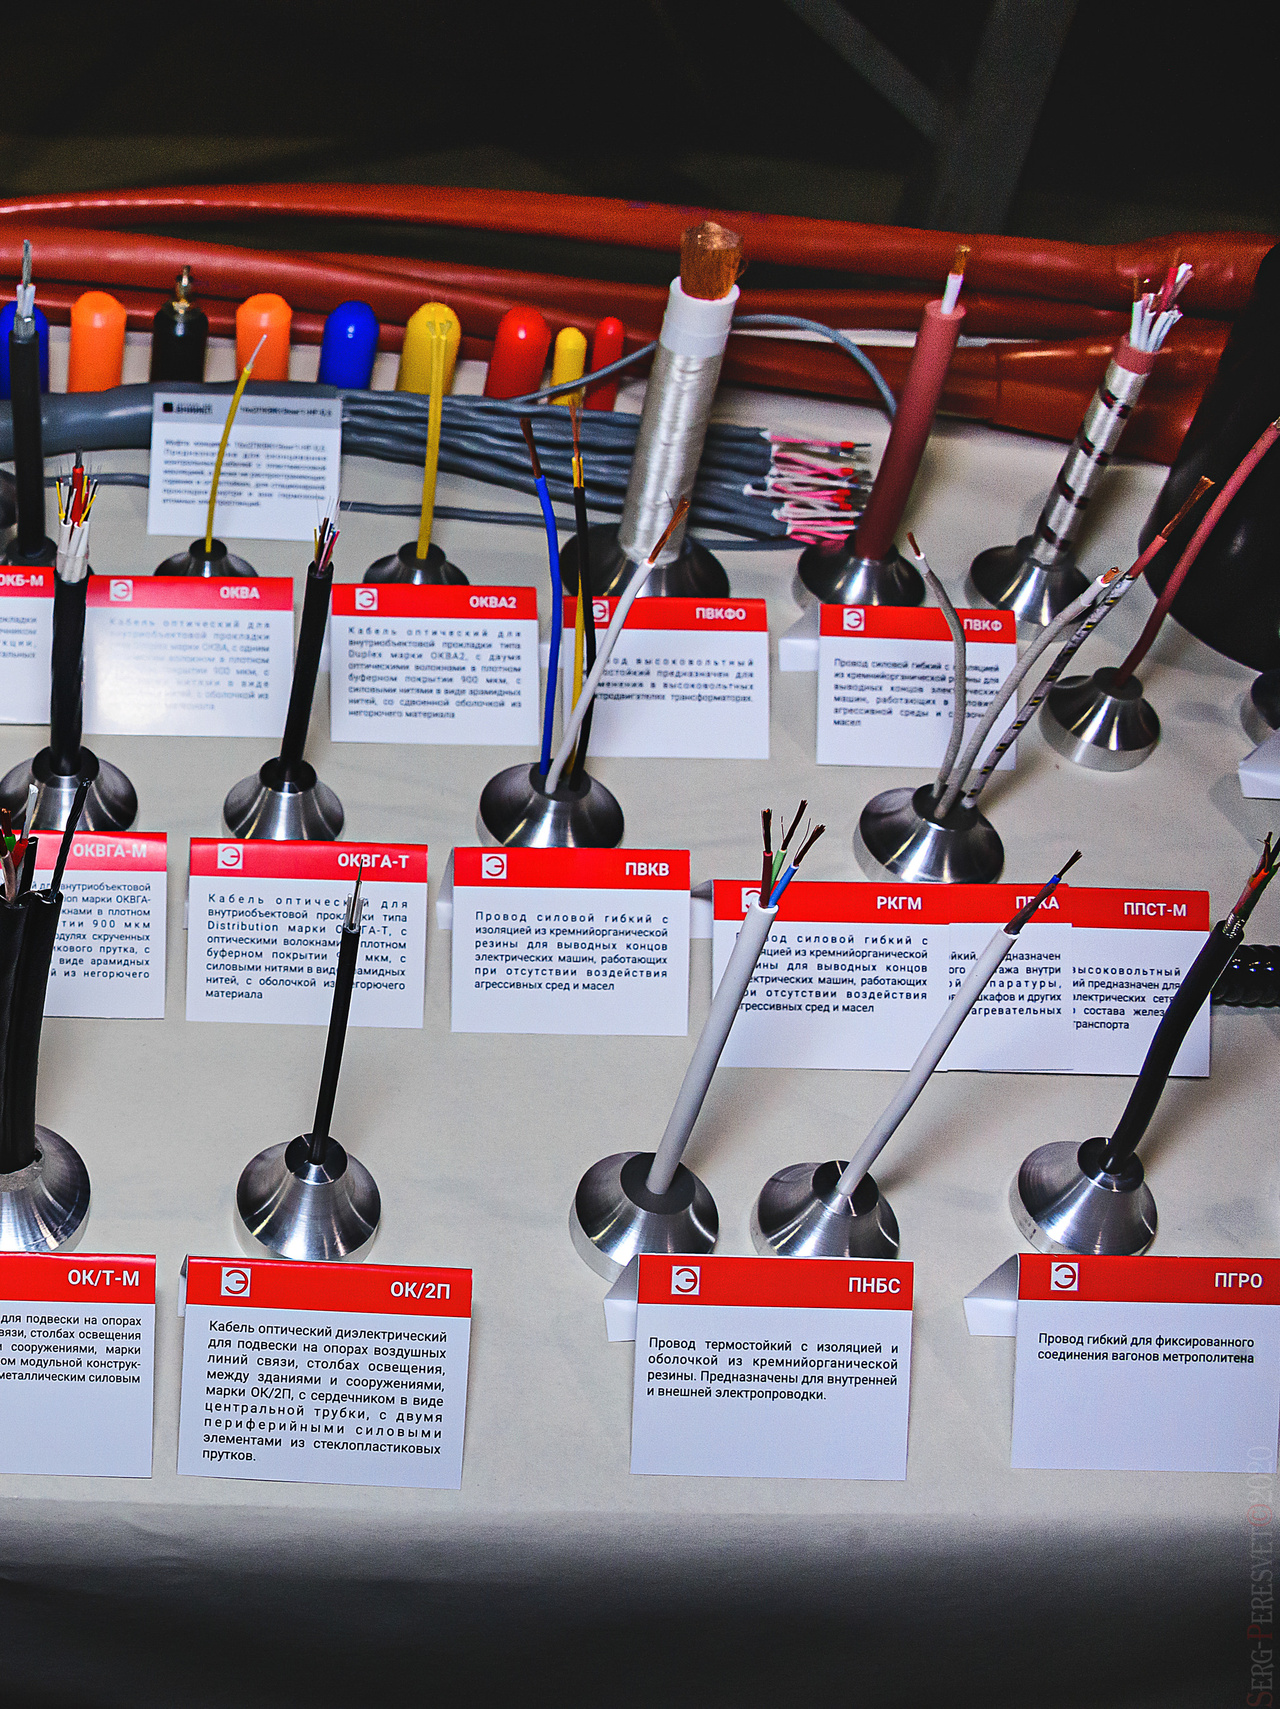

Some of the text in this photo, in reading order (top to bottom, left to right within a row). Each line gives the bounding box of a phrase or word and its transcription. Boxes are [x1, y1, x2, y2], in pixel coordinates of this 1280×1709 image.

[219, 586, 260, 600] ОКВА
[469, 595, 517, 609] ОКВА2
[695, 607, 746, 621] ПВКФО
[963, 618, 1003, 632] ПВКФ
[72, 843, 148, 859] ОКВГА-М
[337, 852, 410, 869] ОКВГА-Т
[625, 861, 670, 877] ПВКВ
[209, 894, 264, 904] Кабель
[876, 895, 922, 911] РКГМ
[208, 908, 308, 919] внутриобъектовой
[1123, 902, 1187, 917] ППСТ-М
[93, 919, 115, 928] 900
[475, 911, 668, 924] Провод силовой гибкий с
[208, 920, 326, 934] Distribution марки
[475, 925, 668, 938] изоляцией из кремнийорганической
[797, 934, 911, 945] силовой гибкий
[474, 981, 543, 991] агрессивных
[545, 982, 570, 992] сред
[582, 983, 615, 991] масел
[1088, 981, 1159, 990] предназначен
[205, 990, 263, 1000] материала
[67, 1269, 140, 1287] ОК/Т-М
[848, 1276, 901, 1294] ПНБС
[1214, 1272, 1263, 1289] ПГРО
[390, 1281, 451, 1300] ОК/2П
[0, 1315, 21, 1324] для
[26, 1315, 79, 1325] подвески
[84, 1317, 97, 1325] на
[102, 1317, 142, 1328] опорах
[30, 1328, 75, 1339] столбах
[78, 1331, 141, 1342] освещения
[209, 1320, 447, 1343] Кабель оптический диэлектрический
[649, 1337, 898, 1355] Провод термостойкий с изоляцией и
[1038, 1332, 1254, 1349] Провод гибкий для фиксированного
[207, 1339, 446, 1360] для подвески на опорах воздушных
[648, 1353, 898, 1371] оболочкой из кремнийорганической
[1037, 1350, 1254, 1365] соединения вагонов метрополитена
[647, 1370, 897, 1387] резины. Предназначены для внутренней
[647, 1386, 826, 1402] и внешней электропроводки.
[203, 1434, 441, 1455] элементами из стеклопластиковых
